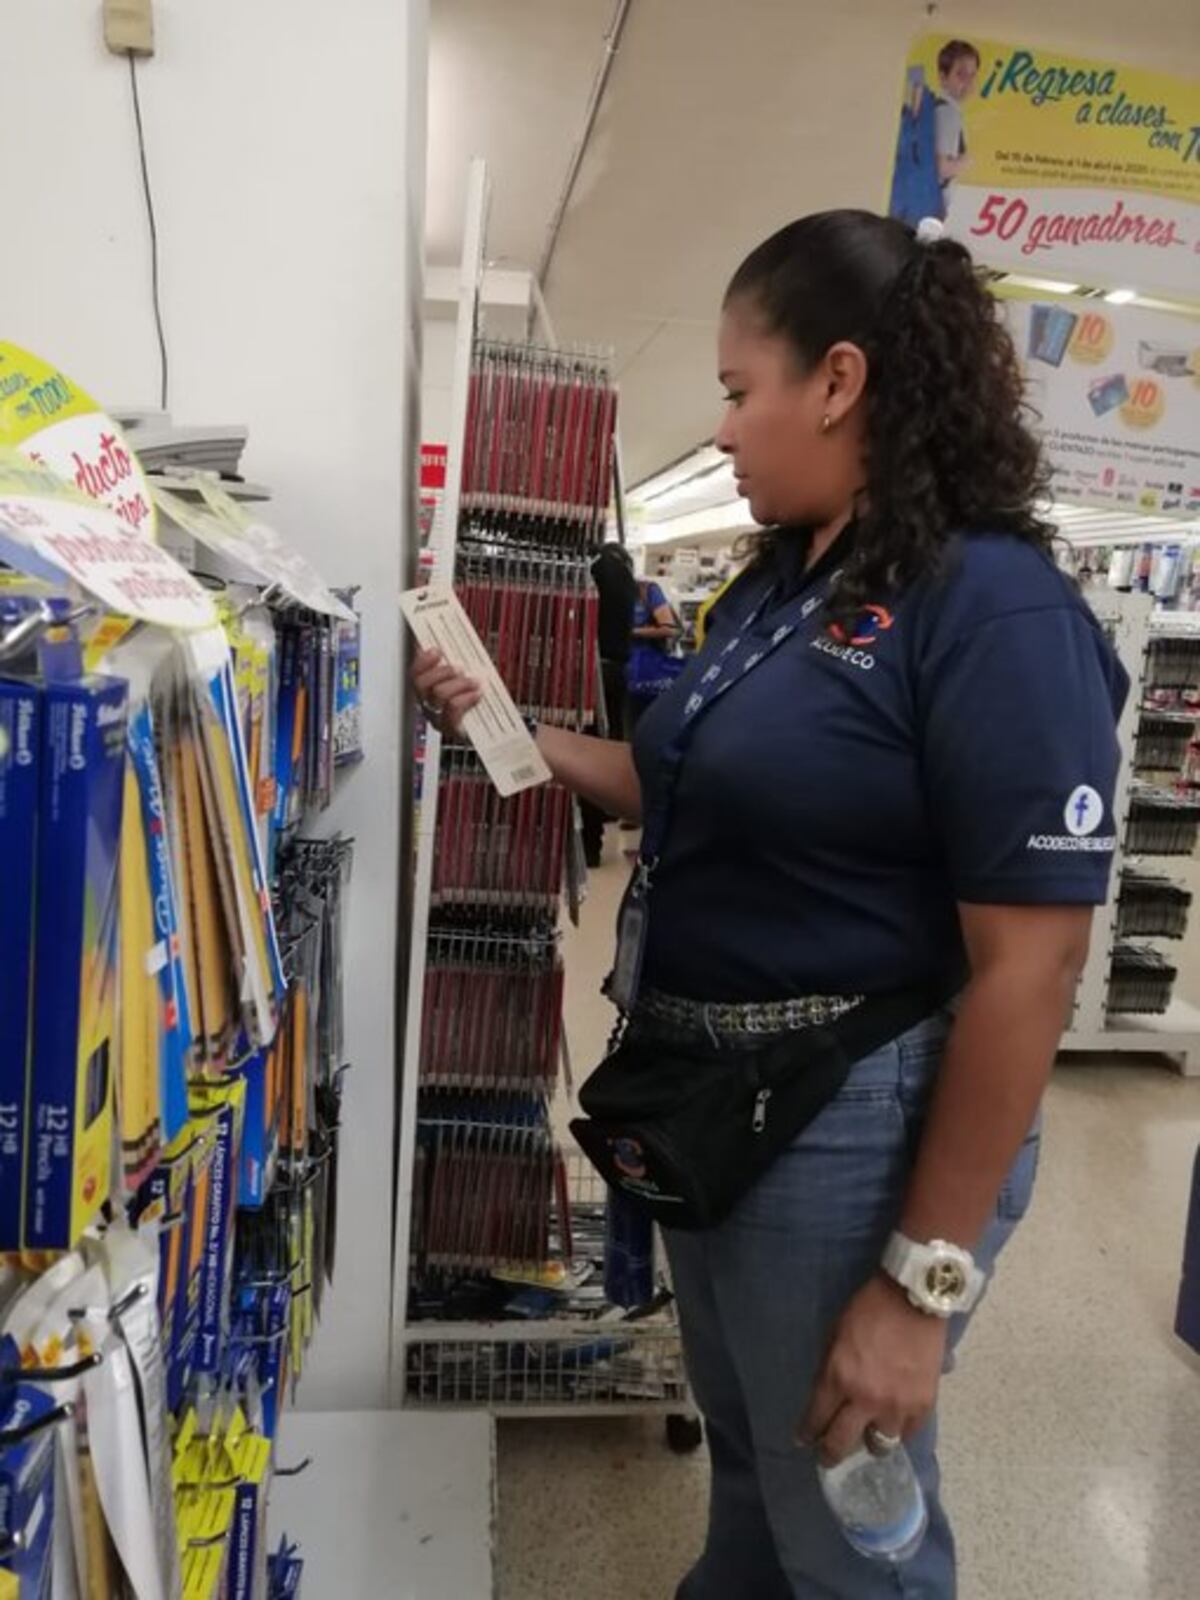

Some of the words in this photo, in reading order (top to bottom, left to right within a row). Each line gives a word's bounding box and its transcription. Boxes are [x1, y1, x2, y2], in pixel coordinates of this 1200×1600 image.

[980, 51, 1117, 106] ¡Regresa
[1075, 102, 1092, 124] a
[1095, 93, 1176, 128] clases
[1148, 129, 1184, 151] con
[1182, 126, 1200, 162] T
[970, 195, 1028, 241] 50
[1021, 200, 1185, 254] ganadores
[1078, 313, 1105, 344] 10
[1131, 380, 1158, 407] 10
[46, 1104, 68, 1131] 12
[36, 1133, 53, 1181] Pencils
[52, 1133, 68, 1157] HB
[210, 1181, 223, 1224] GRAFITO
